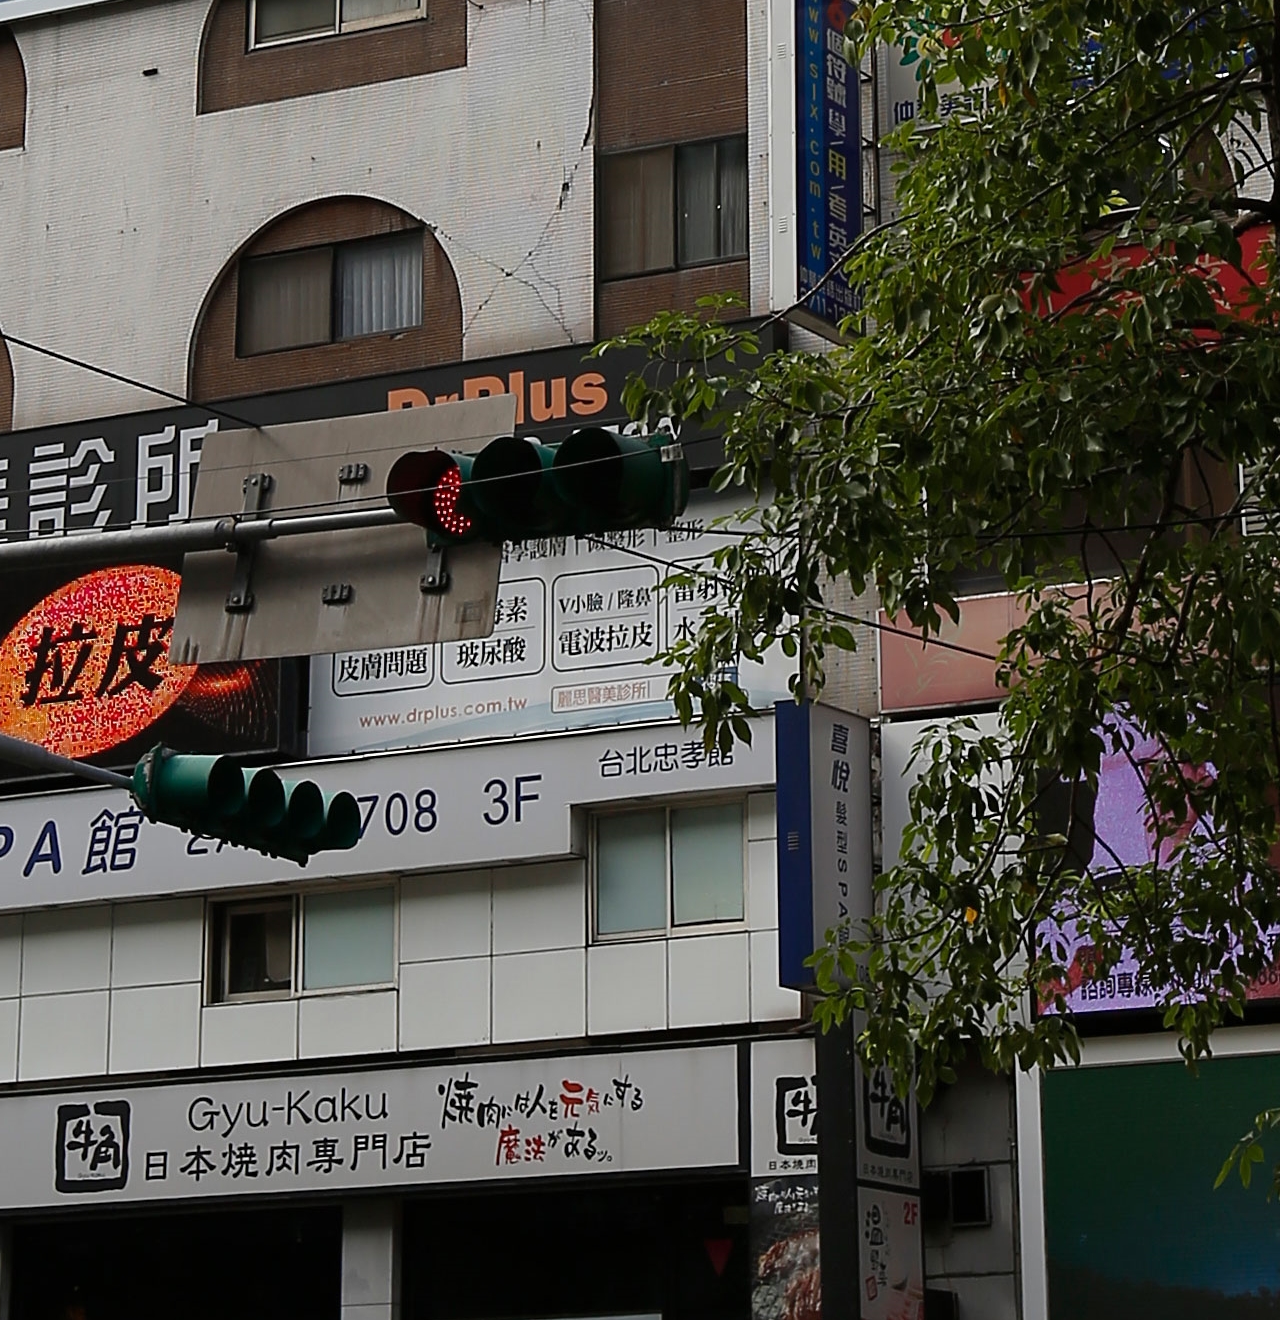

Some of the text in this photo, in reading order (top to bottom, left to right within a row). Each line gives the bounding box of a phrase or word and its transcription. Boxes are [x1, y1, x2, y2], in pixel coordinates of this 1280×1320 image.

[455, 637, 527, 669] 玻尿酸
[558, 620, 653, 657] 電波拉皮
[19, 614, 176, 706] 拉皮
[337, 647, 428, 683] 皮膚問題
[359, 696, 528, 728] www.drplus.com.tw
[556, 681, 647, 708] 麗思醫美診所
[483, 774, 542, 826] 3F
[187, 1086, 390, 1139] Gyu-Kaku
[144, 1131, 434, 1183] 日本焼肉専門店
[902, 1201, 919, 1226] 2F
